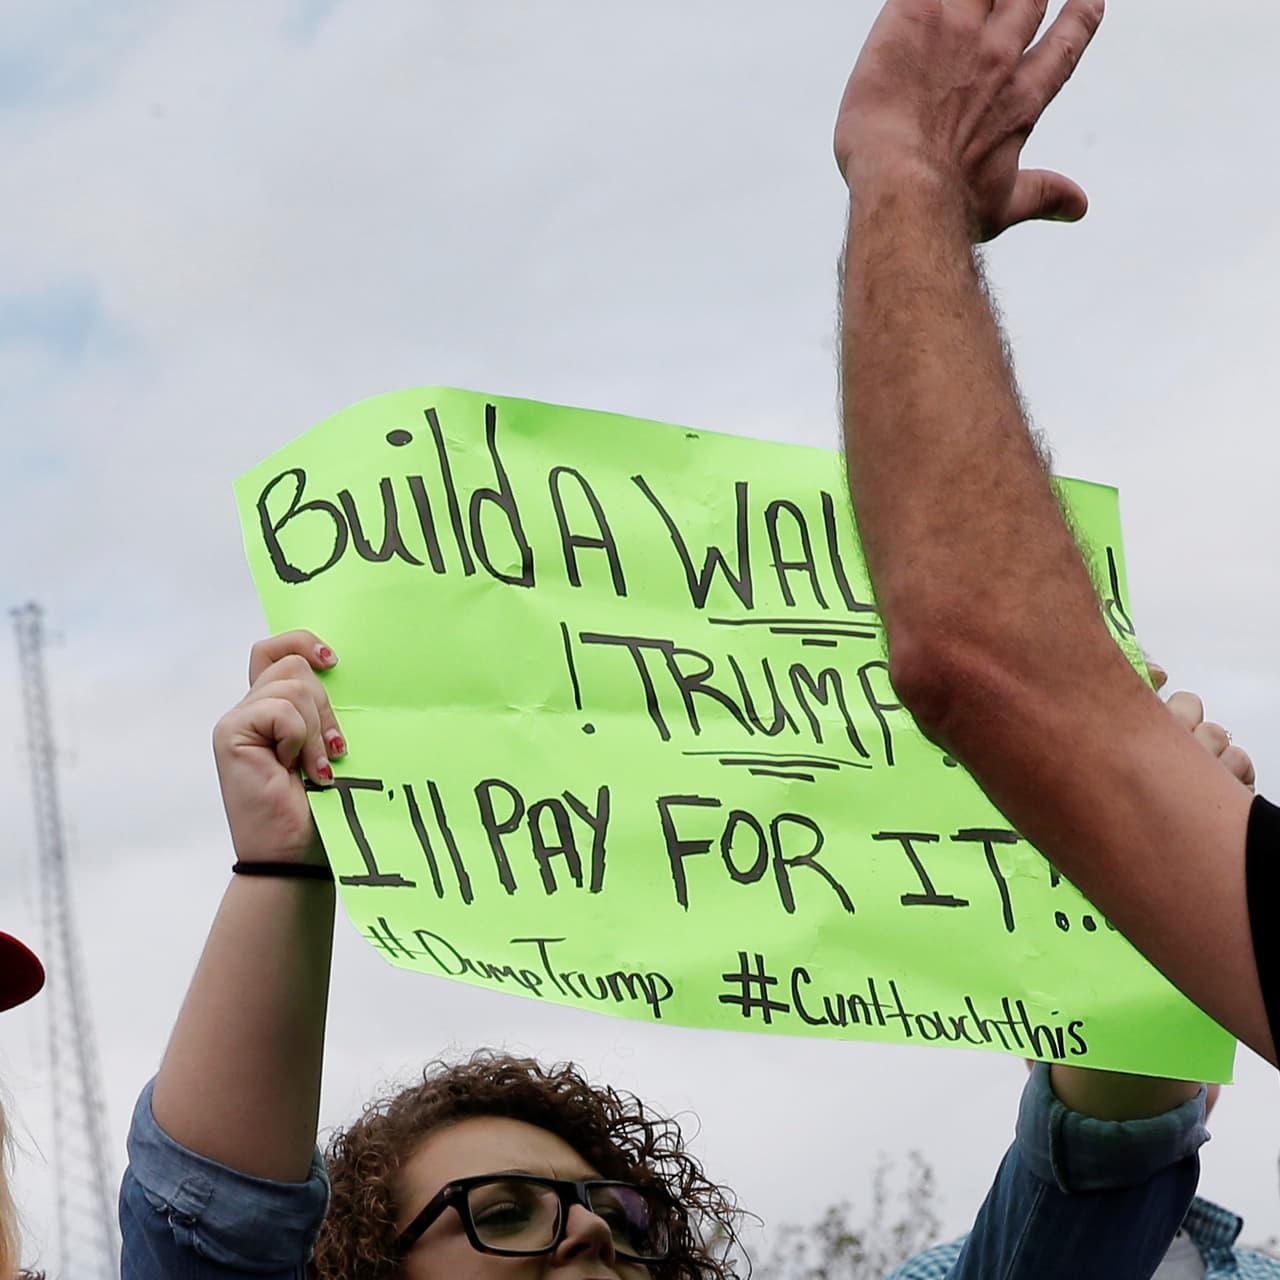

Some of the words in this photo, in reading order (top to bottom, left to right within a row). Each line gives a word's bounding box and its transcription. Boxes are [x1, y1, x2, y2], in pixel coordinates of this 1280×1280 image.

[257, 404, 535, 588] Build
[549, 464, 630, 597] A
[631, 474, 878, 613] WAL
[477, 779, 611, 896] PAY
[657, 795, 856, 914] FOR
[362, 916, 675, 1019] #DumpTrump
